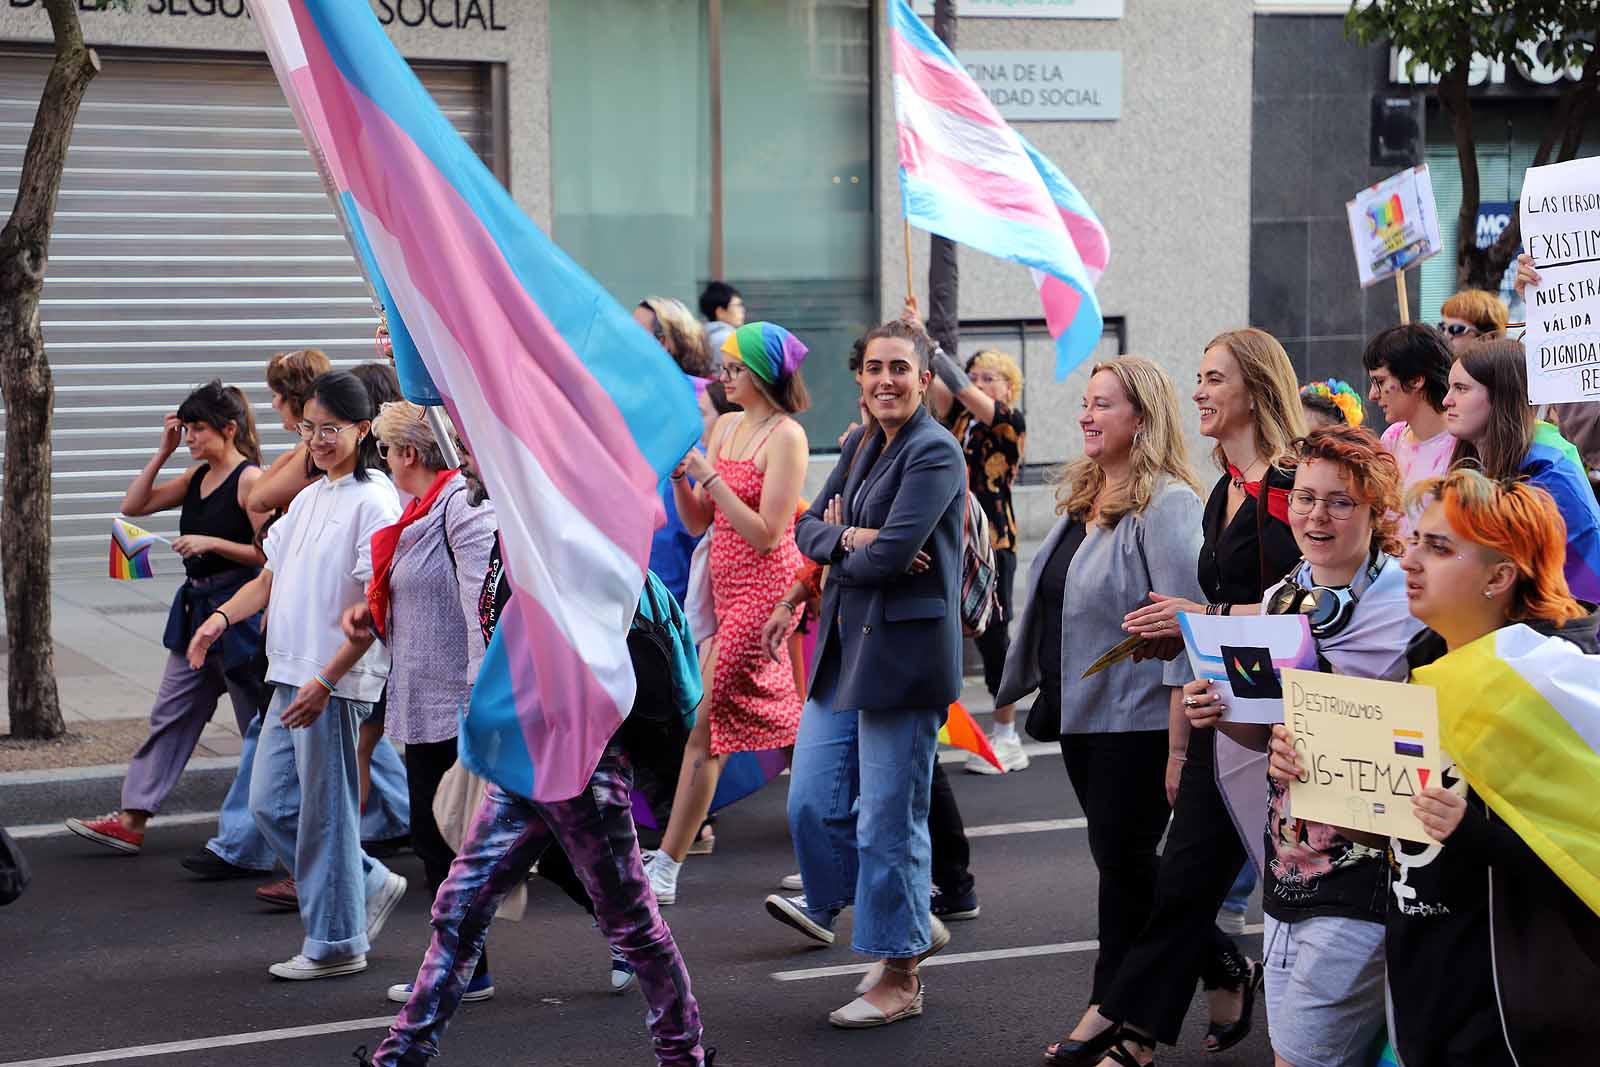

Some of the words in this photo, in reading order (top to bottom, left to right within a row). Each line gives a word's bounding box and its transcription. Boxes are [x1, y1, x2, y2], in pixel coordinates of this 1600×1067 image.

[376, 0, 507, 31] SOCIAL
[1013, 63, 1037, 81] DE
[1041, 63, 1064, 81] LA
[1039, 88, 1102, 106] SOCIAL
[1528, 195, 1558, 214] LAS
[1540, 342, 1600, 369] DIGNIDA
[1291, 681, 1383, 720] DESTRUYAMOS
[1293, 712, 1315, 737] EL
